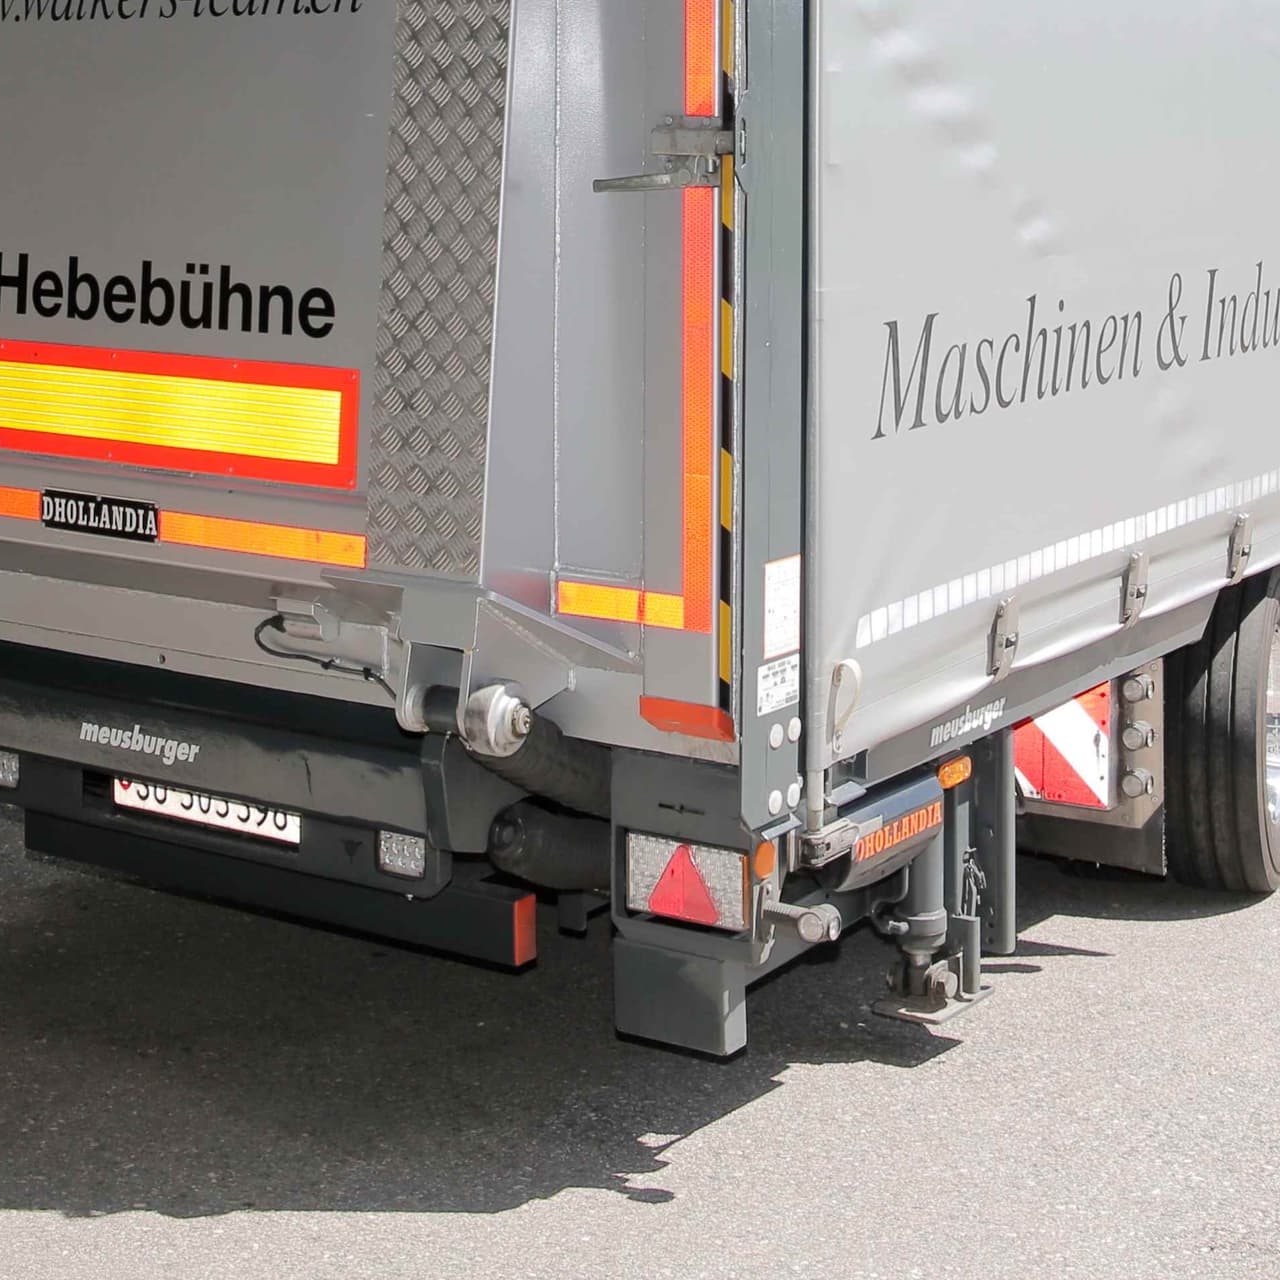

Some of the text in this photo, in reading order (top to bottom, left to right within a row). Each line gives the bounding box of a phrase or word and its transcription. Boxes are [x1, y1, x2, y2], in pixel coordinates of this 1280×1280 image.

[870, 293, 1145, 441] Maschinen
[1155, 272, 1188, 372] &
[41, 495, 158, 536] DHOLLANDIA
[78, 720, 201, 767] meusburger
[929, 696, 1007, 748] meusburger
[855, 801, 943, 863] DHOLLANDIA
